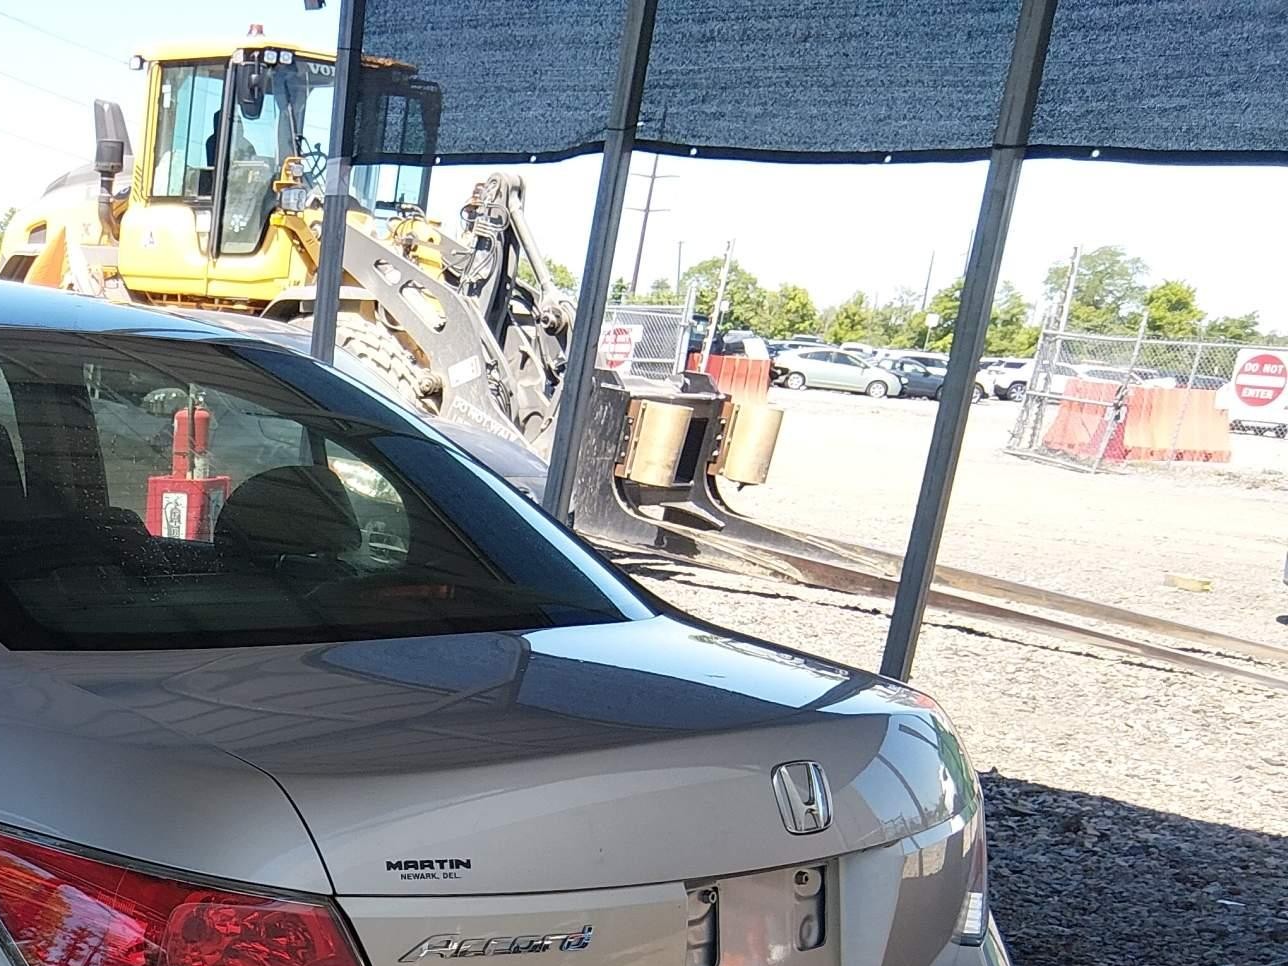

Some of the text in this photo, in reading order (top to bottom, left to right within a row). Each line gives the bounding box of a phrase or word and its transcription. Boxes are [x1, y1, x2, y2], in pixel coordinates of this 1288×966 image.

[1244, 362, 1283, 374] DO NOT
[386, 859, 472, 871] MARTIN
[400, 872, 440, 880] NEWARK,
[397, 924, 593, 963] Accord
